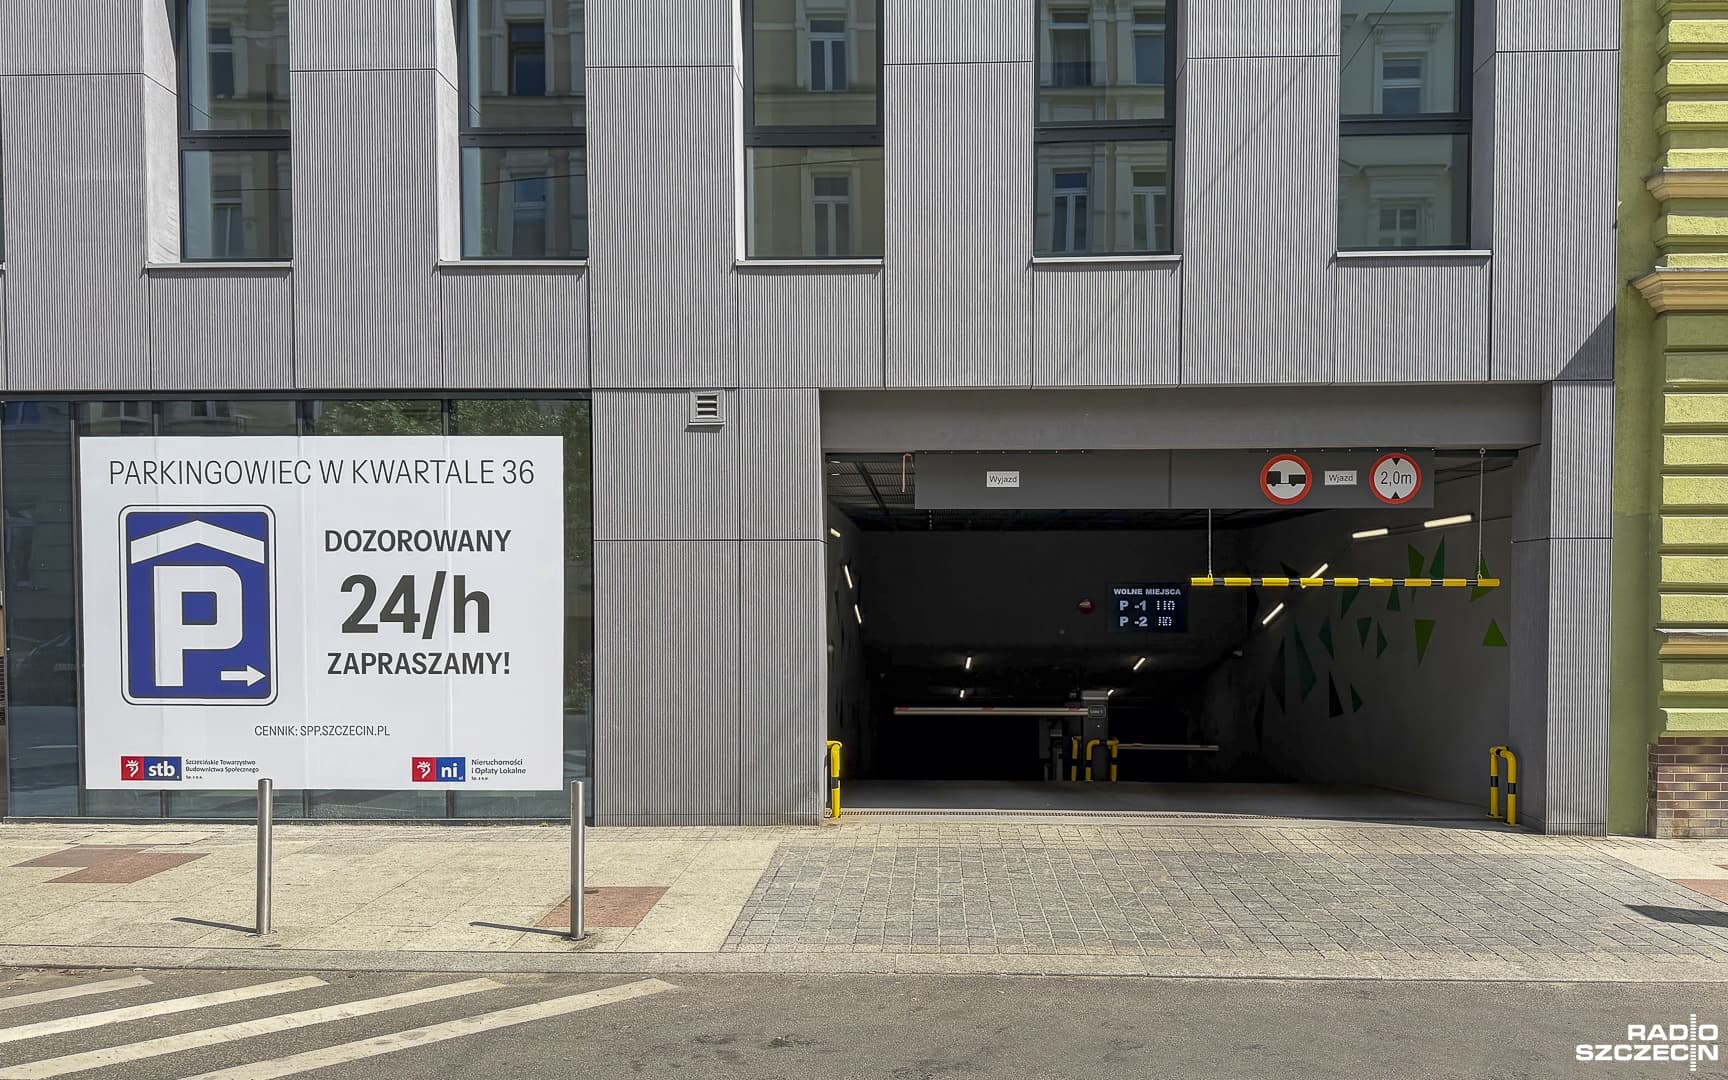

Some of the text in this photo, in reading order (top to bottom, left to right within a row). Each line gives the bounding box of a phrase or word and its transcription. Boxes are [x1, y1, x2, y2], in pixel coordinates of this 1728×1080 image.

[109, 460, 535, 485] PARKINGOWIEC W KWARTALE 36
[1328, 473, 1354, 483] Wjazd
[989, 474, 1018, 485] Wyjazd
[1380, 471, 1412, 486] 2,0m
[324, 529, 512, 552] DOZOROWANY
[340, 570, 491, 640] 24/h
[1119, 600, 1129, 611] P
[1134, 600, 1147, 611] -1
[153, 565, 243, 687] P
[1119, 616, 1129, 627] P
[1134, 616, 1148, 627] -2
[327, 652, 510, 675] ZAPRASZAMY!
[254, 725, 391, 737] CENNIK: SPP.SZCZECIN.PL
[185, 758, 256, 767] Szczecińskie Towarzystwo
[471, 758, 523, 766] Nieruchomości
[224, 766, 260, 774] Społecznego
[475, 767, 498, 776] Opłaty
[499, 767, 527, 775] Lokalne
